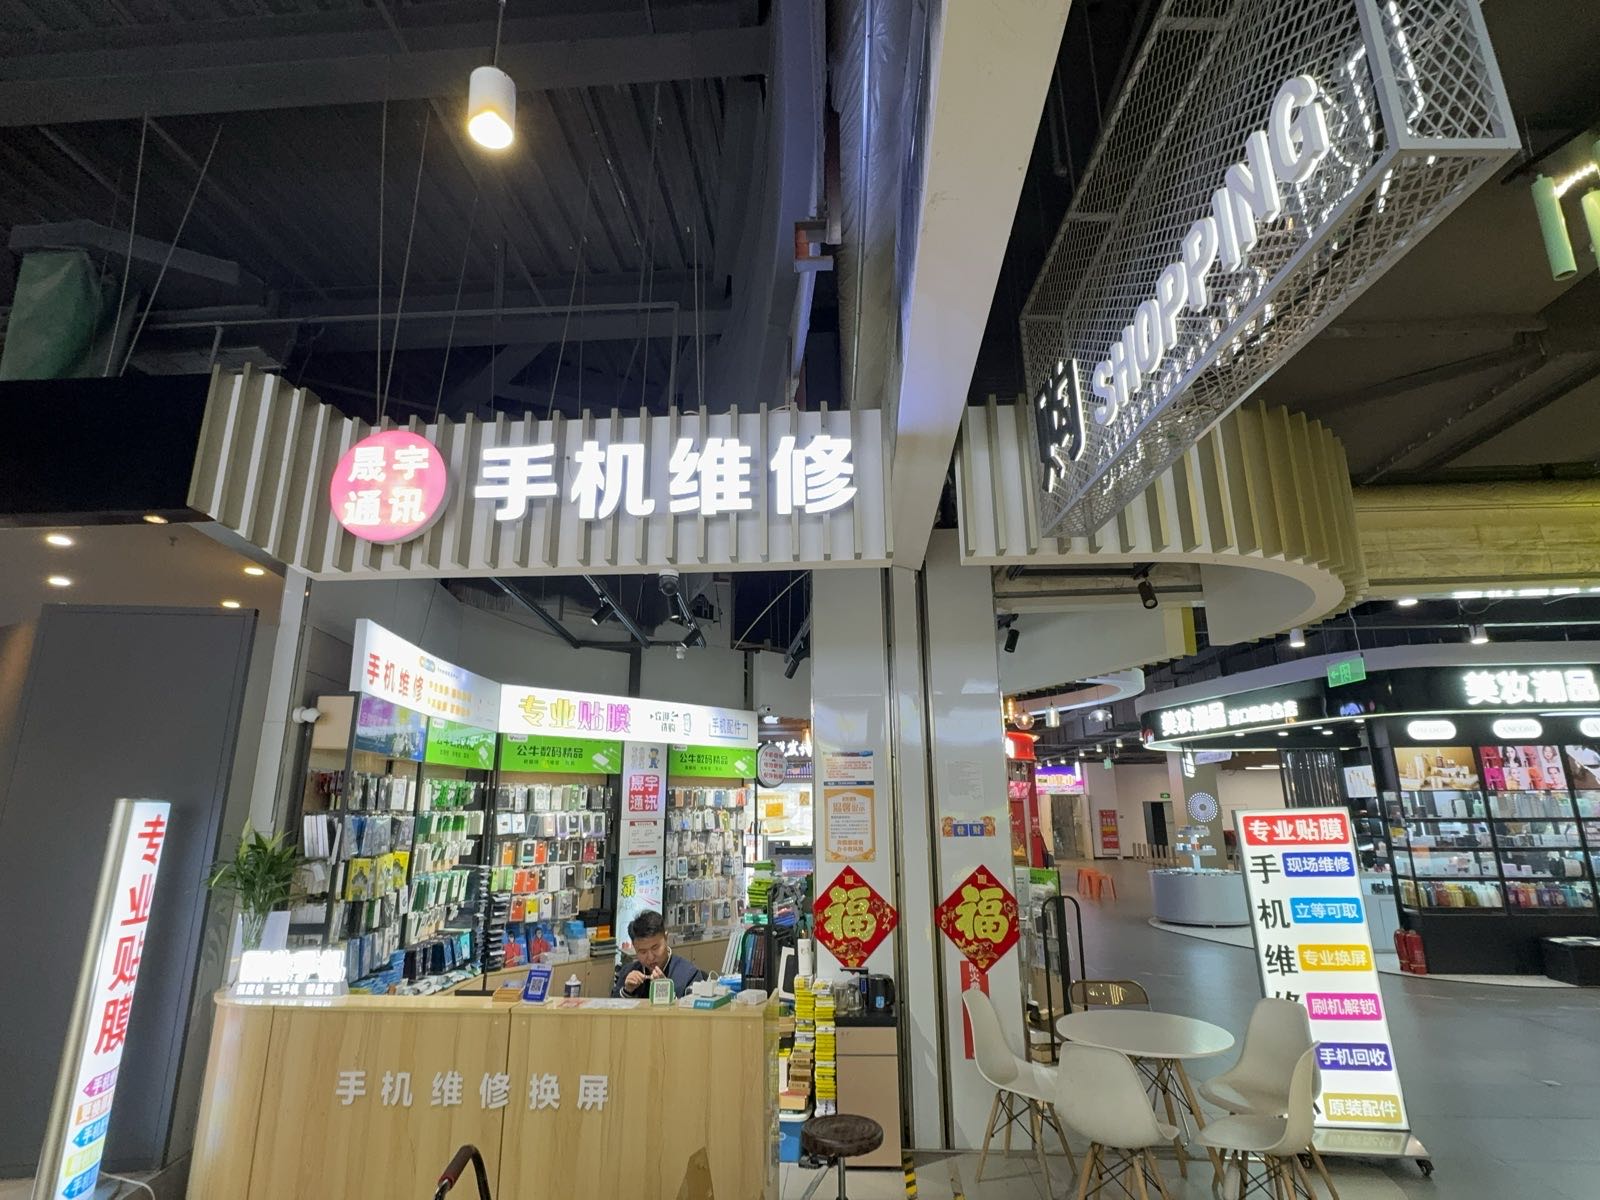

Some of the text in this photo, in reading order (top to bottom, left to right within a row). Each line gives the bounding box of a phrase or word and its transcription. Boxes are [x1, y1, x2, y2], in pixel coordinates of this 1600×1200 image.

[1092, 74, 1329, 427] SHOPPING
[348, 444, 430, 482] 晟宇
[474, 435, 858, 522] 手机维修
[343, 486, 427, 526] 通讯
[367, 653, 425, 703] 手机维修
[1463, 670, 1600, 705] 美妆潮品
[518, 694, 632, 734] 专业贴膜
[516, 744, 584, 759] 公牛数码精品
[679, 752, 729, 765] 公牛数码精品
[630, 794, 659, 811] 通讯
[1248, 818, 1344, 843] 专业贴膜
[1287, 856, 1351, 873] 现场维修
[824, 886, 877, 942] 福
[955, 884, 1010, 944] 福
[1250, 853, 1301, 1003] 手机维
[1295, 903, 1360, 919] 立等可取
[94, 813, 166, 1056] 专业贴膜
[1303, 949, 1368, 967] 专业换屏
[1311, 998, 1378, 1016] 刷机解锁
[1319, 1047, 1388, 1067] 手机回收
[335, 1070, 610, 1112] 手机维修换屏
[1328, 1098, 1398, 1118] 原装配件
